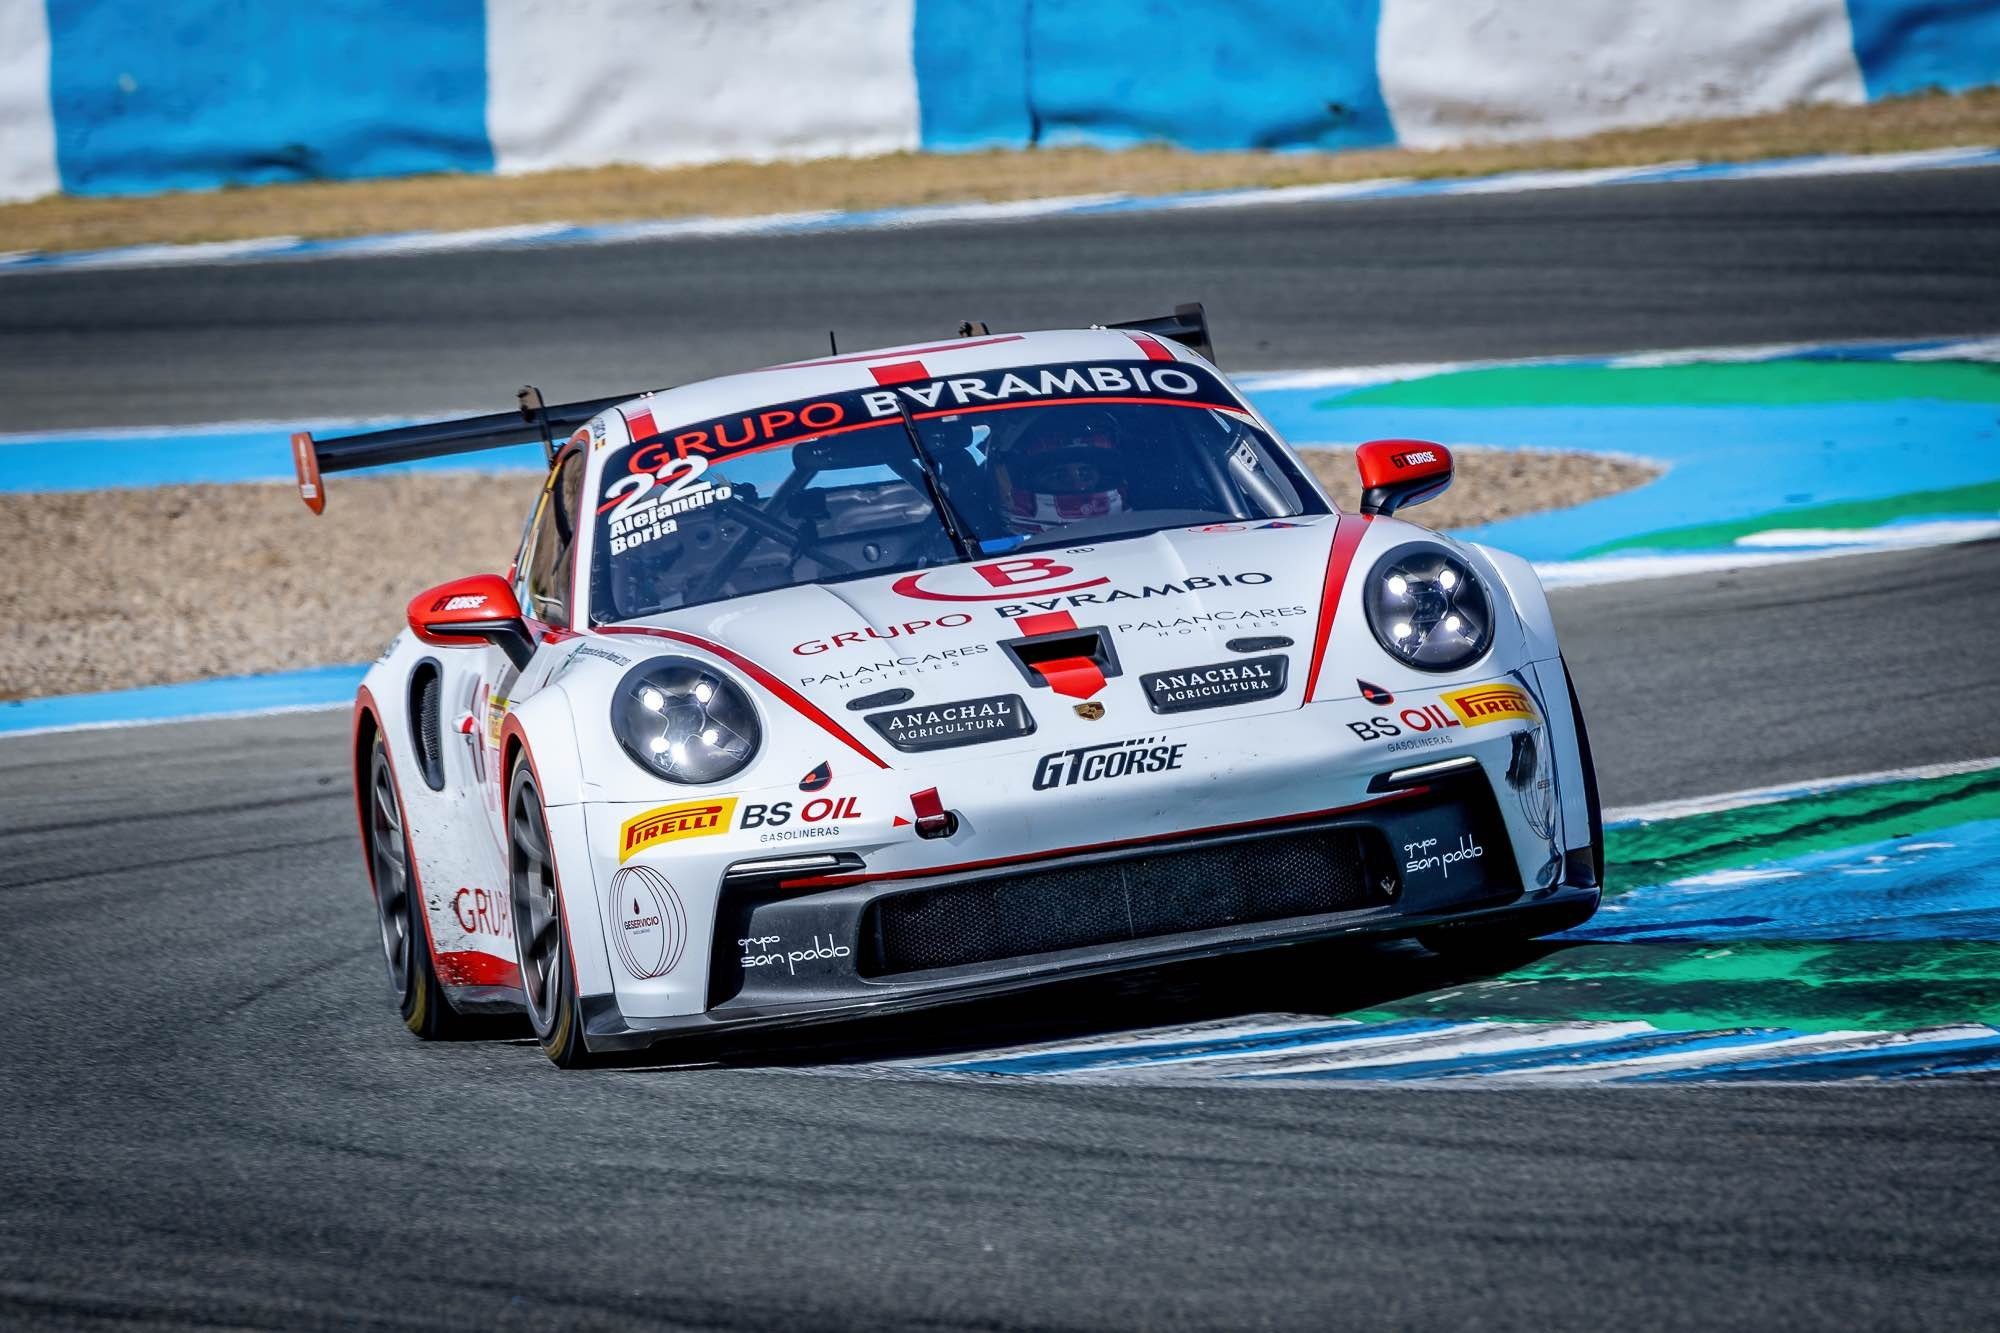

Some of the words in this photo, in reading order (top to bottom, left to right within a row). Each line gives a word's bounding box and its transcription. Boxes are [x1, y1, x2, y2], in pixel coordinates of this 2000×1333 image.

[628, 402, 844, 475] GRUPO
[605, 455, 712, 525] 22
[610, 485, 732, 539] Alejandro
[610, 519, 678, 556] Borja
[793, 613, 972, 655] GRUPO
[1118, 605, 1307, 633] PALANCARES
[1158, 620, 1279, 637] HOTELES
[801, 644, 988, 687] PALANCARES
[840, 661, 960, 689] HOTELES
[1154, 664, 1271, 692] ANACHAL
[1167, 680, 1269, 702] AGRICULTURA
[889, 701, 1011, 730] ANACHAL
[898, 717, 1005, 741] AGRICULTURA
[1346, 716, 1401, 742] BS
[1400, 704, 1460, 732] OIL
[1387, 735, 1453, 753] GASOLINERAS
[625, 805, 723, 851] PIRELLI
[740, 801, 793, 830] BS
[801, 796, 862, 822] OIL
[760, 826, 840, 843] GASOLINERAS
[1406, 855, 1440, 873] san
[1443, 834, 1483, 878] pablo
[740, 952, 785, 968] san
[788, 934, 850, 975] pablo
